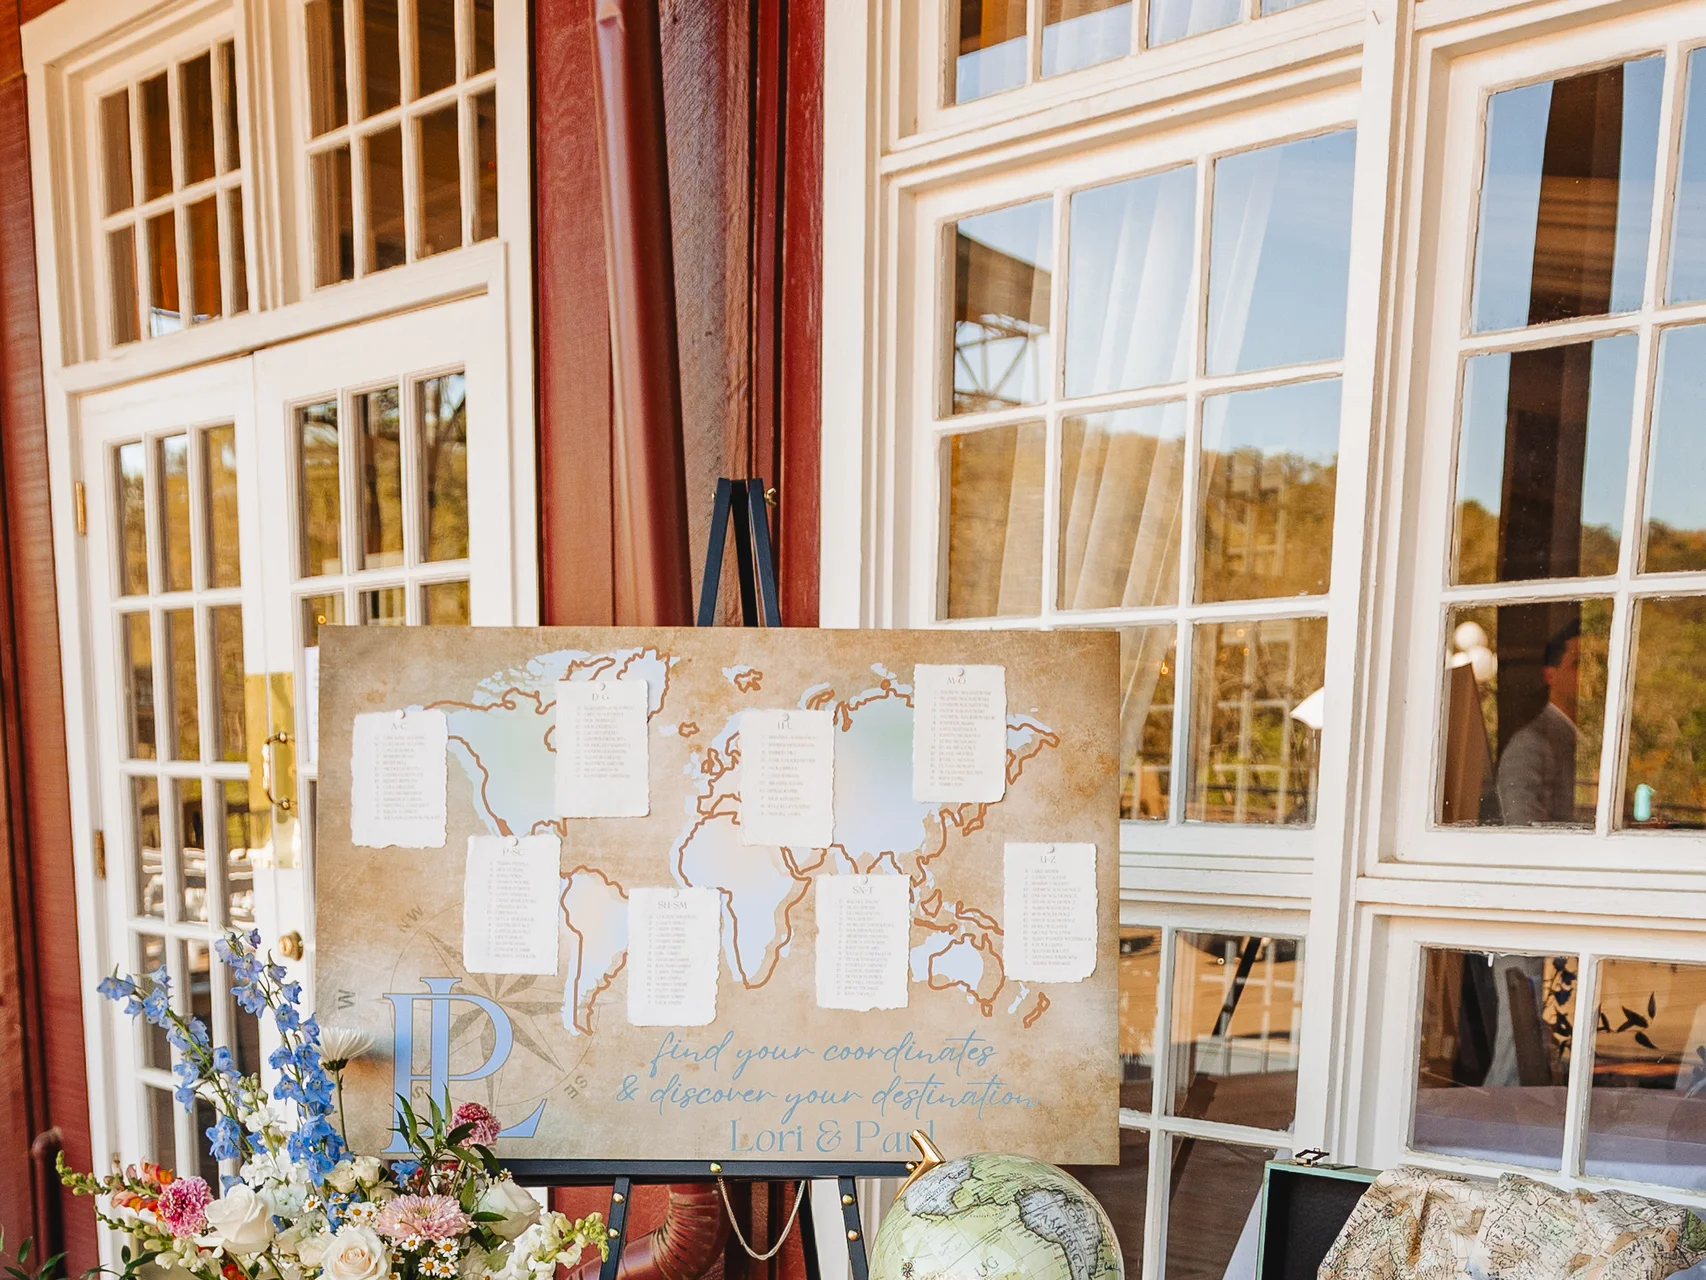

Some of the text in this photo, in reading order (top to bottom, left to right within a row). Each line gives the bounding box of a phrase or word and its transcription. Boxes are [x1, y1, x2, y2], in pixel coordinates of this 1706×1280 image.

[946, 676, 967, 685] M-O
[1040, 855, 1057, 864] U-Z
[852, 885, 875, 895] SN-T
[657, 900, 688, 910] SH-SM
[650, 1030, 998, 1080] find your coordinates
[615, 1073, 1040, 1124] & discover your destination
[729, 1118, 803, 1153] Lori
[815, 1118, 842, 1153] &
